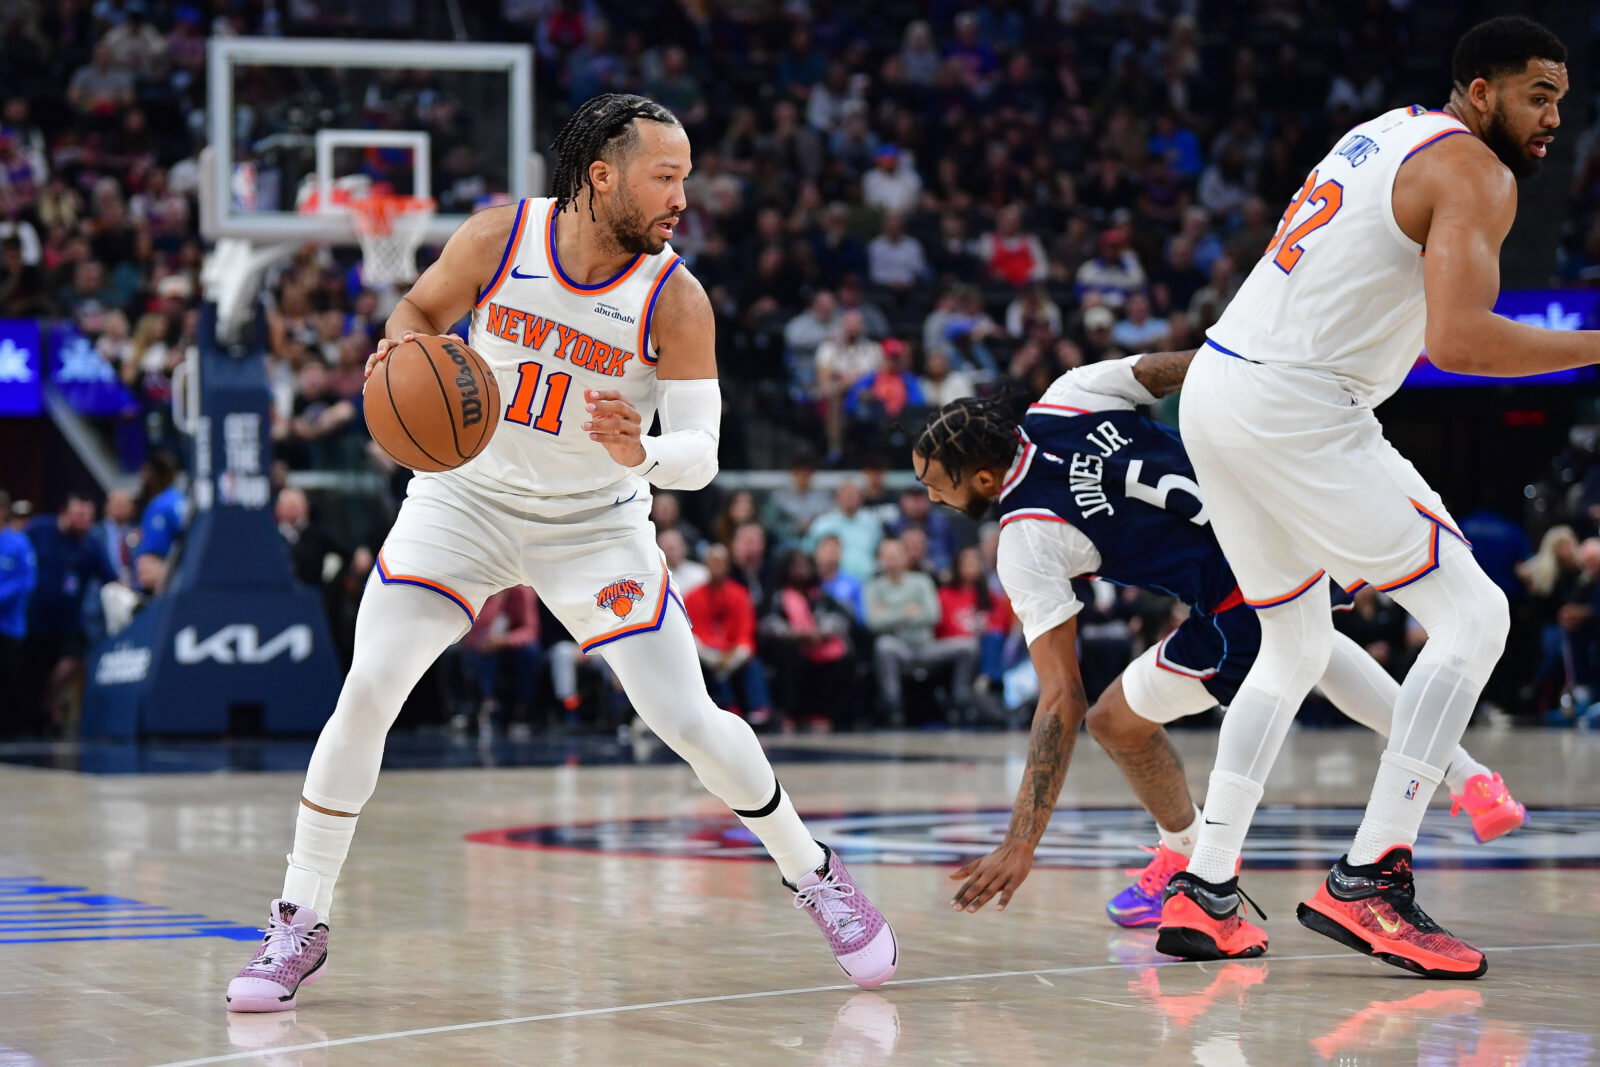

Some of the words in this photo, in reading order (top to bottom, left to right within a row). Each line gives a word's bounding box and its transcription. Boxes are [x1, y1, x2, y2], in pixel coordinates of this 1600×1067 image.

[486, 302, 555, 351] NEW
[554, 323, 635, 377] YORK
[594, 307, 611, 317] abu
[611, 311, 636, 325] dhabi
[441, 343, 482, 429] Wilson
[504, 361, 572, 436] 11
[1086, 420, 1133, 457] JR.
[1069, 452, 1115, 519] JONES
[1125, 459, 1210, 526] 5
[597, 579, 645, 607] KNICKS
[174, 623, 312, 664] KIA
